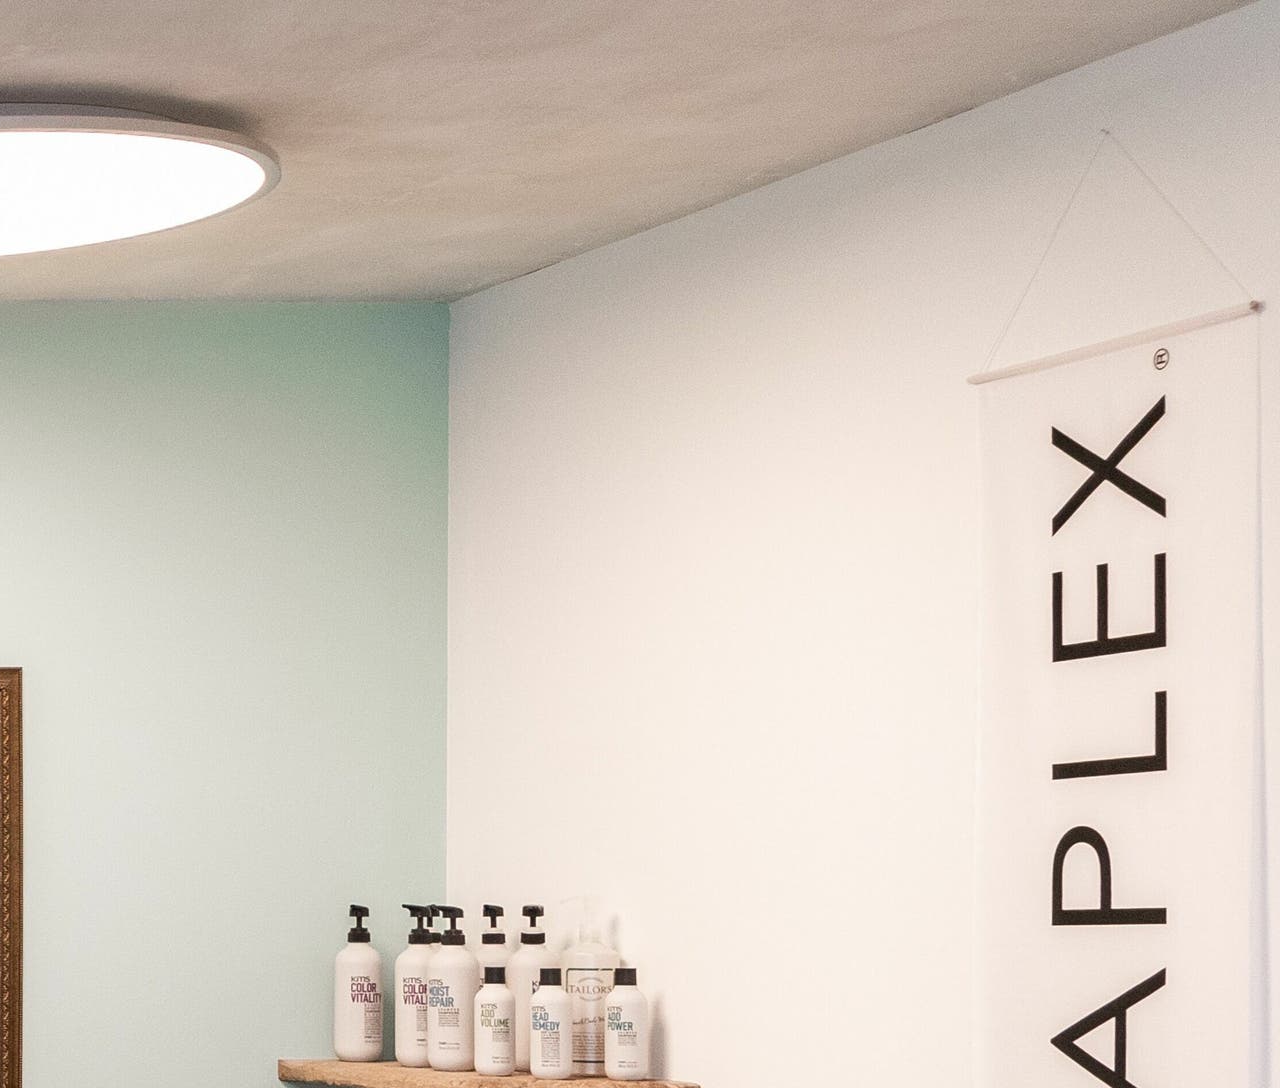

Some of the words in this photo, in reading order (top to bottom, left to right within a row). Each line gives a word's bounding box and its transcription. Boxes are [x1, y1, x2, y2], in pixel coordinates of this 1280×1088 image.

[350, 983, 377, 993] COLOR
[428, 996, 455, 1008] REPAIR
[481, 1009, 495, 1018] ADD
[607, 1012, 622, 1021] ADD
[481, 1018, 510, 1028] VOLUME
[532, 1021, 560, 1031] REMEDY
[607, 1021, 634, 1031] POWER
